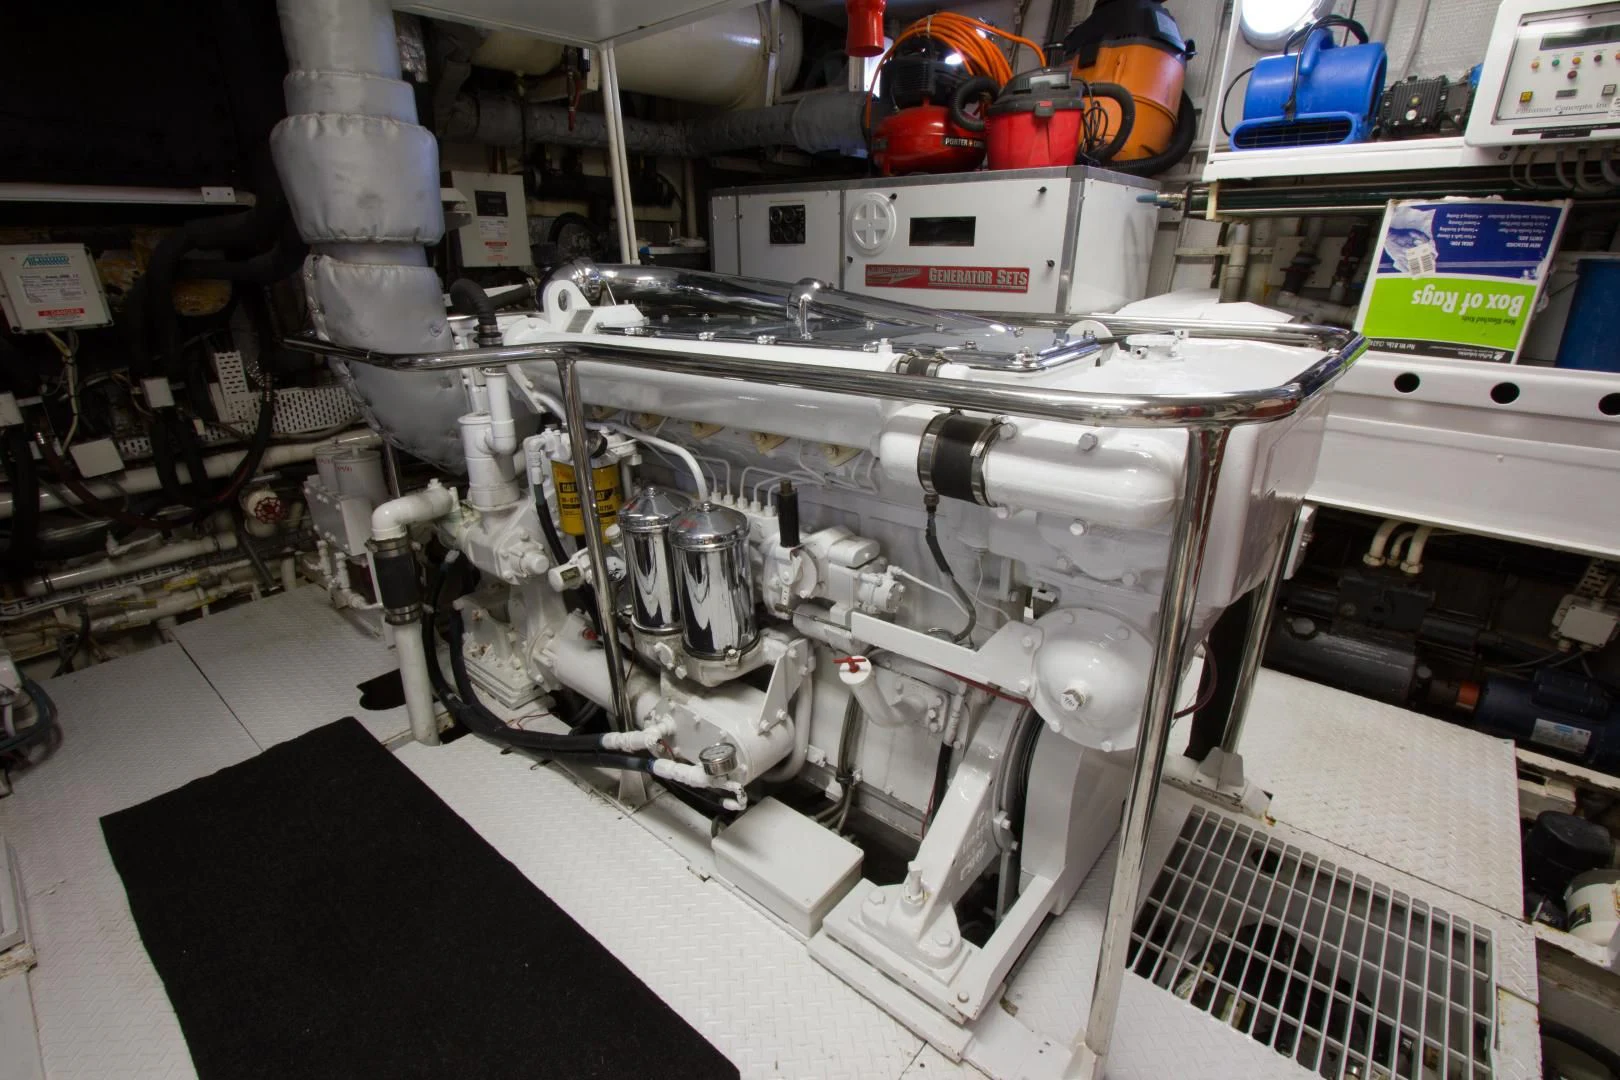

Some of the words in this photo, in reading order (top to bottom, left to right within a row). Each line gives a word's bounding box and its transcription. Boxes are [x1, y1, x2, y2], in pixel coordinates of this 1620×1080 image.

[945, 137, 968, 146] PORTER
[928, 267, 993, 285] GENERATOR
[997, 269, 1028, 286] SETS
[1411, 283, 1458, 313] Rags
[1458, 292, 1483, 316] of
[1485, 294, 1525, 318] Box
